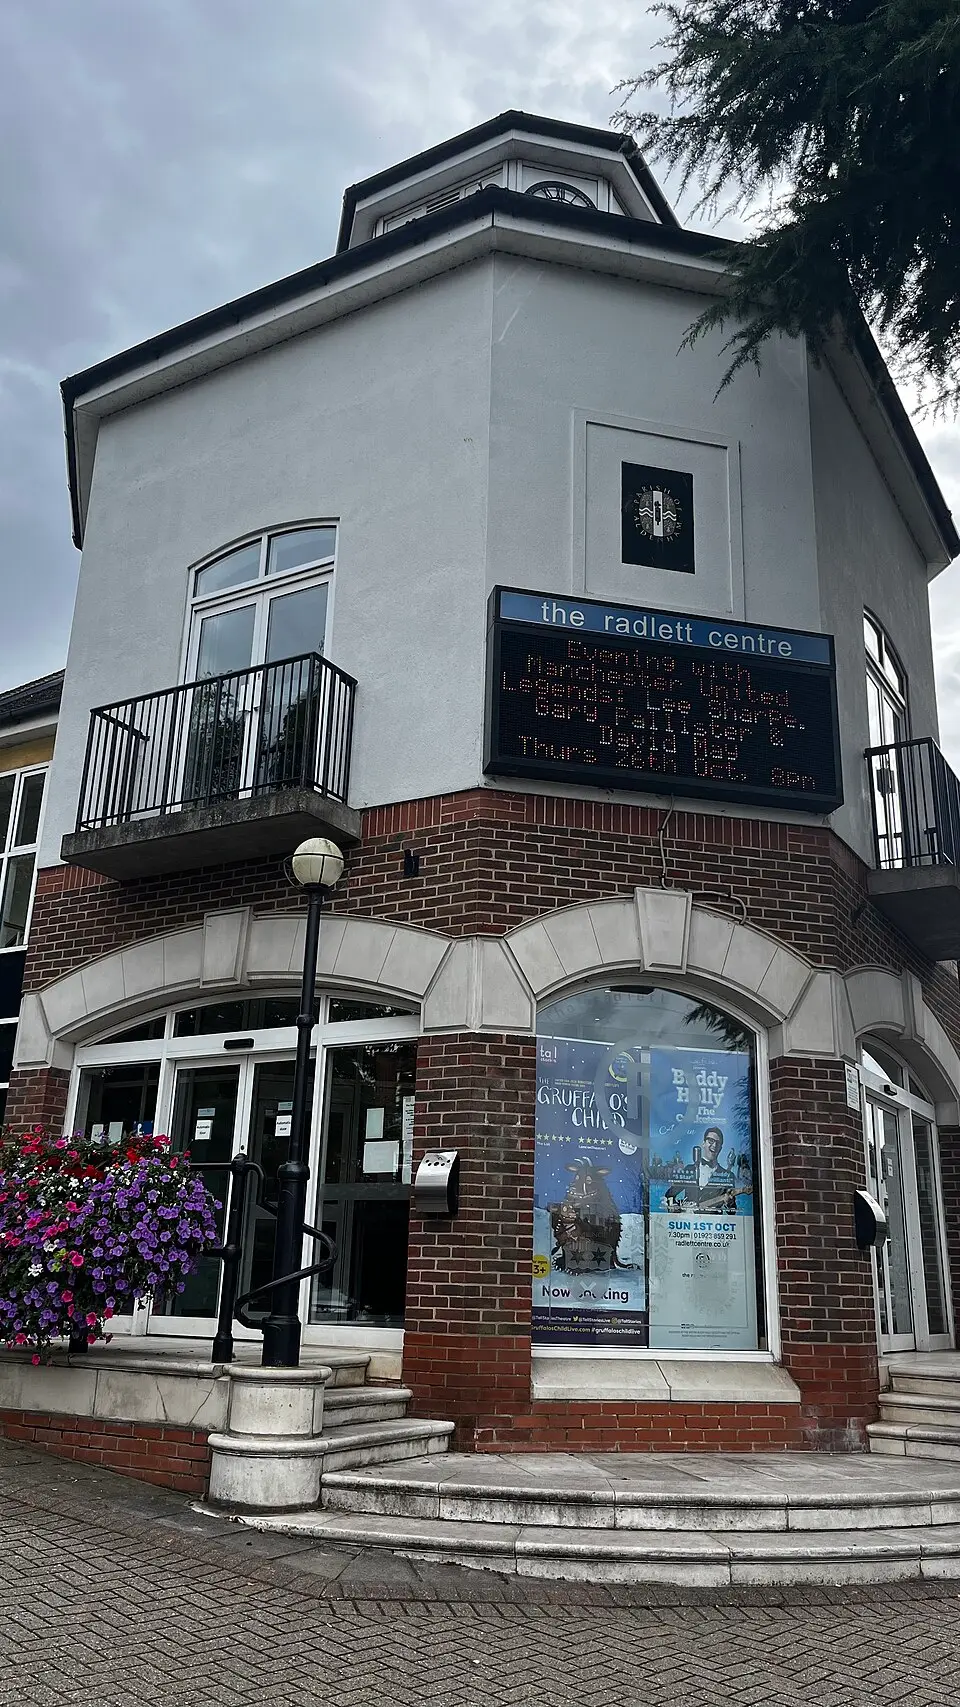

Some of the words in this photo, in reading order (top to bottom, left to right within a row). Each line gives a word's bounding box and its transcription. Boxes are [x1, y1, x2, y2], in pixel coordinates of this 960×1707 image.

[541, 602, 585, 627] the
[604, 614, 693, 643] radlett
[708, 630, 792, 657] centre
[568, 640, 675, 672] Evening
[692, 660, 750, 681] with
[503, 671, 624, 703] Legends:
[647, 690, 691, 714] Lee
[527, 654, 683, 691] Manchester
[700, 678, 789, 707] United
[535, 697, 597, 723] Gary
[769, 727, 784, 746] &
[599, 725, 677, 753] David
[693, 732, 738, 760] May
[518, 735, 597, 763] Thurs
[615, 748, 677, 773] 26th
[771, 767, 816, 790] 8pm
[540, 1045, 557, 1059] tal
[671, 1068, 728, 1092] Bddy
[537, 1085, 628, 1112] GRUFFAO'S
[676, 1087, 724, 1108] Hlly
[697, 1106, 715, 1115] The
[668, 1221, 691, 1230] SUN
[694, 1222, 713, 1231] 1ST
[715, 1223, 736, 1232] OCT
[675, 1240, 730, 1248] radlettcentre.co.uk
[533, 1265, 546, 1274] 3+
[542, 1285, 570, 1298] Now
